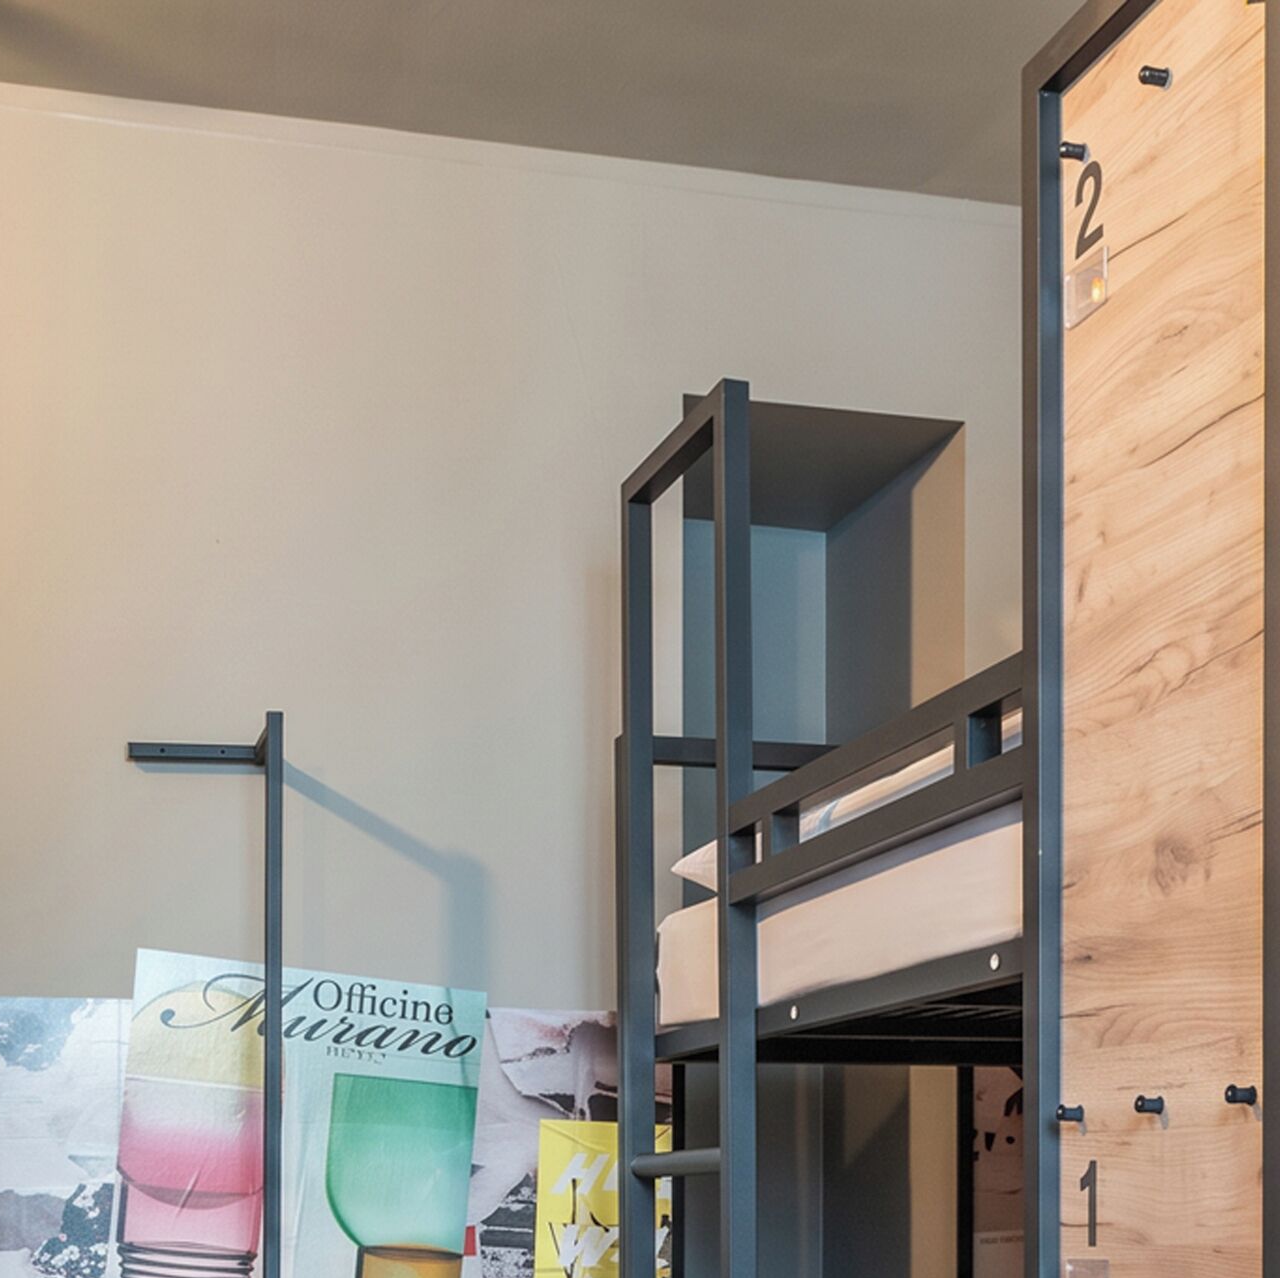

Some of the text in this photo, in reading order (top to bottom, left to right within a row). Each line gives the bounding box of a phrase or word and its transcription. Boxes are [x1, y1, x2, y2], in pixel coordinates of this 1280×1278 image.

[1075, 160, 1104, 261] 2
[160, 973, 477, 1059] Murano
[1080, 1159, 1097, 1247] 1
